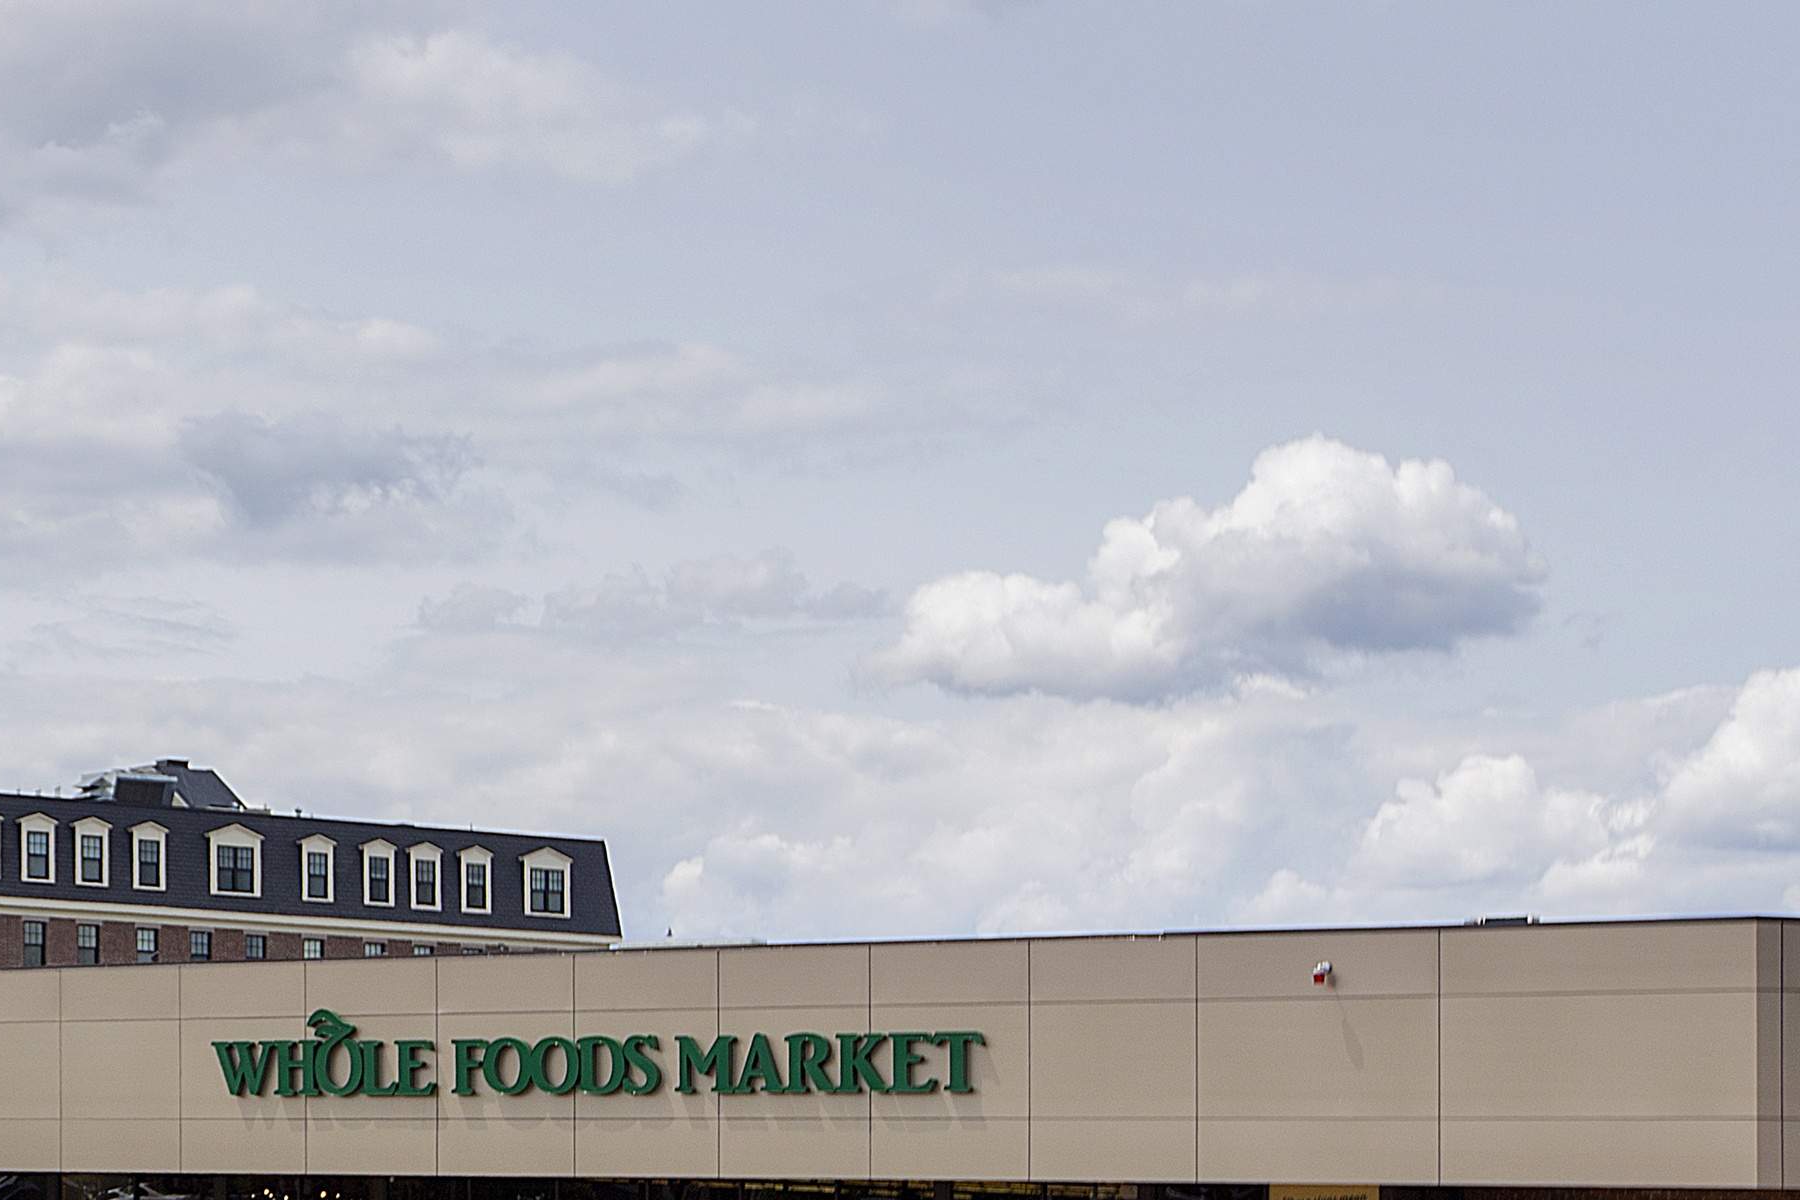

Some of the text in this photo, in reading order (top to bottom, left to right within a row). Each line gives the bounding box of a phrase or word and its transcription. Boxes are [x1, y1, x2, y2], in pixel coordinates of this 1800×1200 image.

[211, 1009, 987, 1097] WHOLE FOODS MARKET
